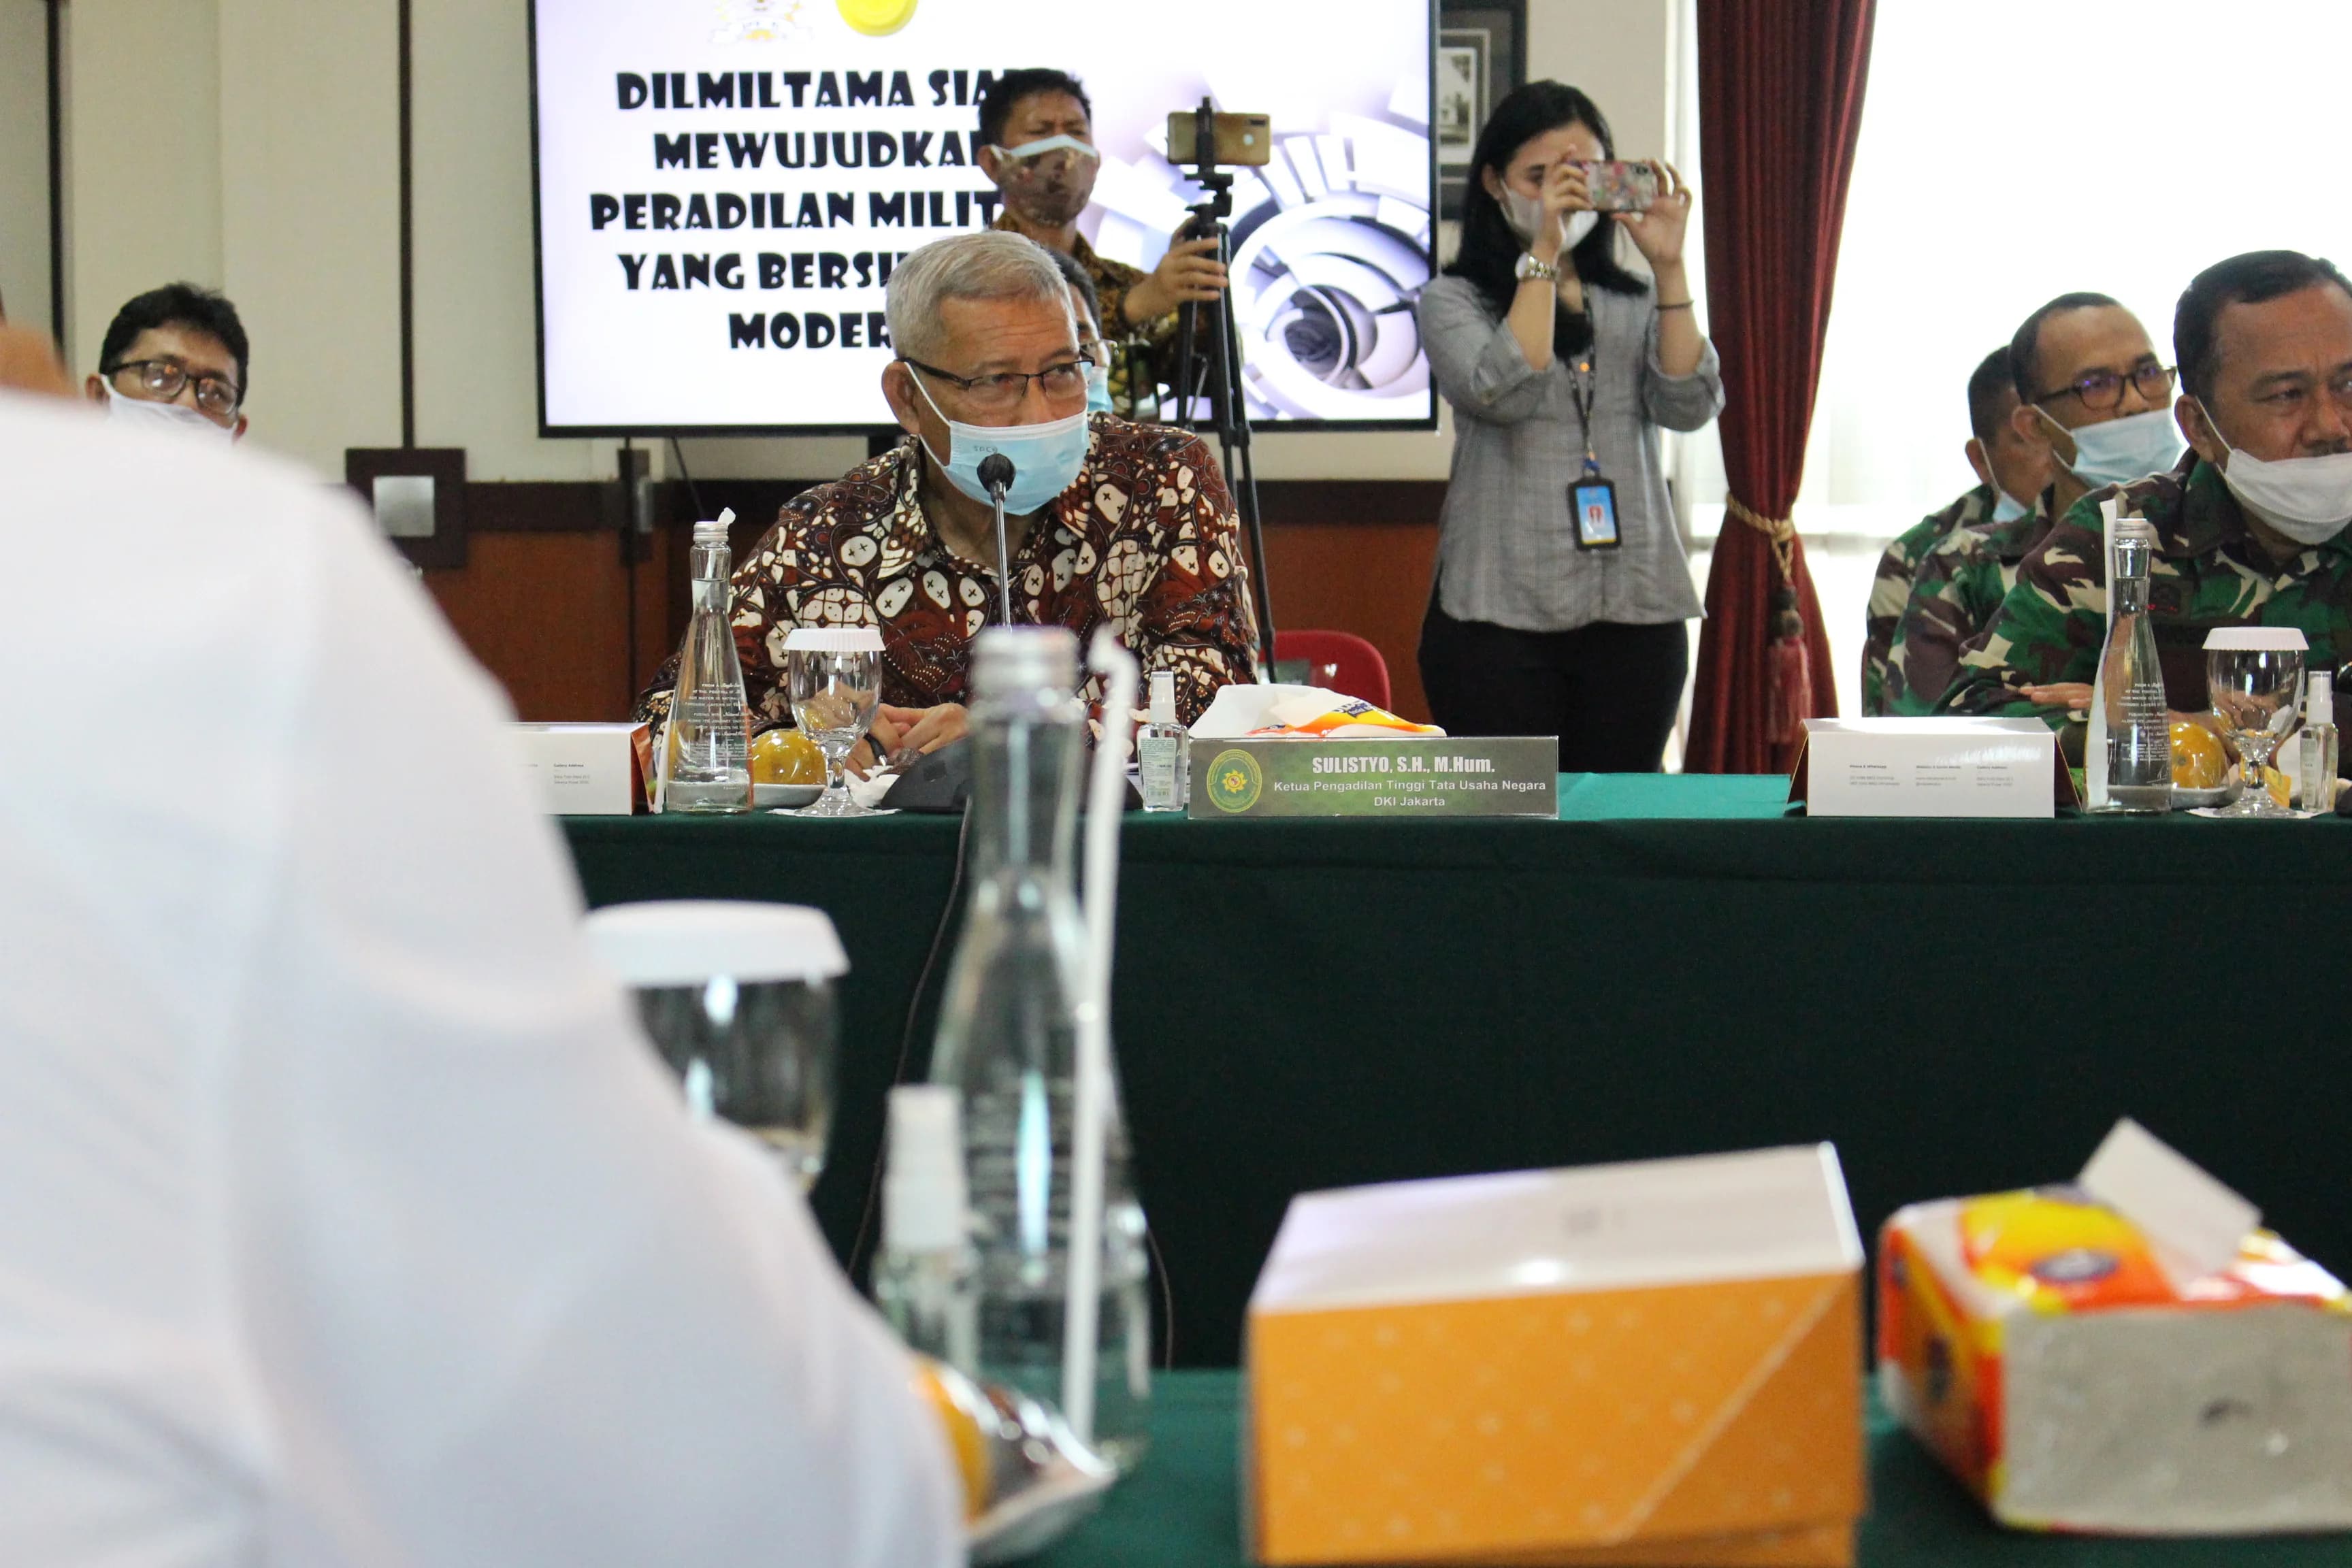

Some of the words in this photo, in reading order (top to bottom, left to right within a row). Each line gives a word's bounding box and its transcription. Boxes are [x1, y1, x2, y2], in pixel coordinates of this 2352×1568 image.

[617, 71, 915, 110] DILMILTAMA
[928, 69, 1006, 107] SIA
[590, 192, 853, 230] PERADILAN
[869, 191, 1003, 227] MILIT
[617, 252, 745, 290] YANG
[758, 251, 906, 289] BERSI
[729, 312, 891, 349] MODER
[1312, 756, 1393, 774] SULISTYO,
[1397, 756, 1431, 774] S.H.,
[1434, 756, 1495, 773] M.Hum.
[1274, 781, 1309, 791] Ketua
[1314, 781, 1382, 793] Pengadilan
[1387, 780, 1425, 792] Tinggi
[1430, 780, 1456, 790] Tata
[1460, 780, 1498, 790] Usaha
[1502, 780, 1546, 793] Negara
[1374, 796, 1396, 806] DKI
[1400, 796, 1446, 806] Jakarta
